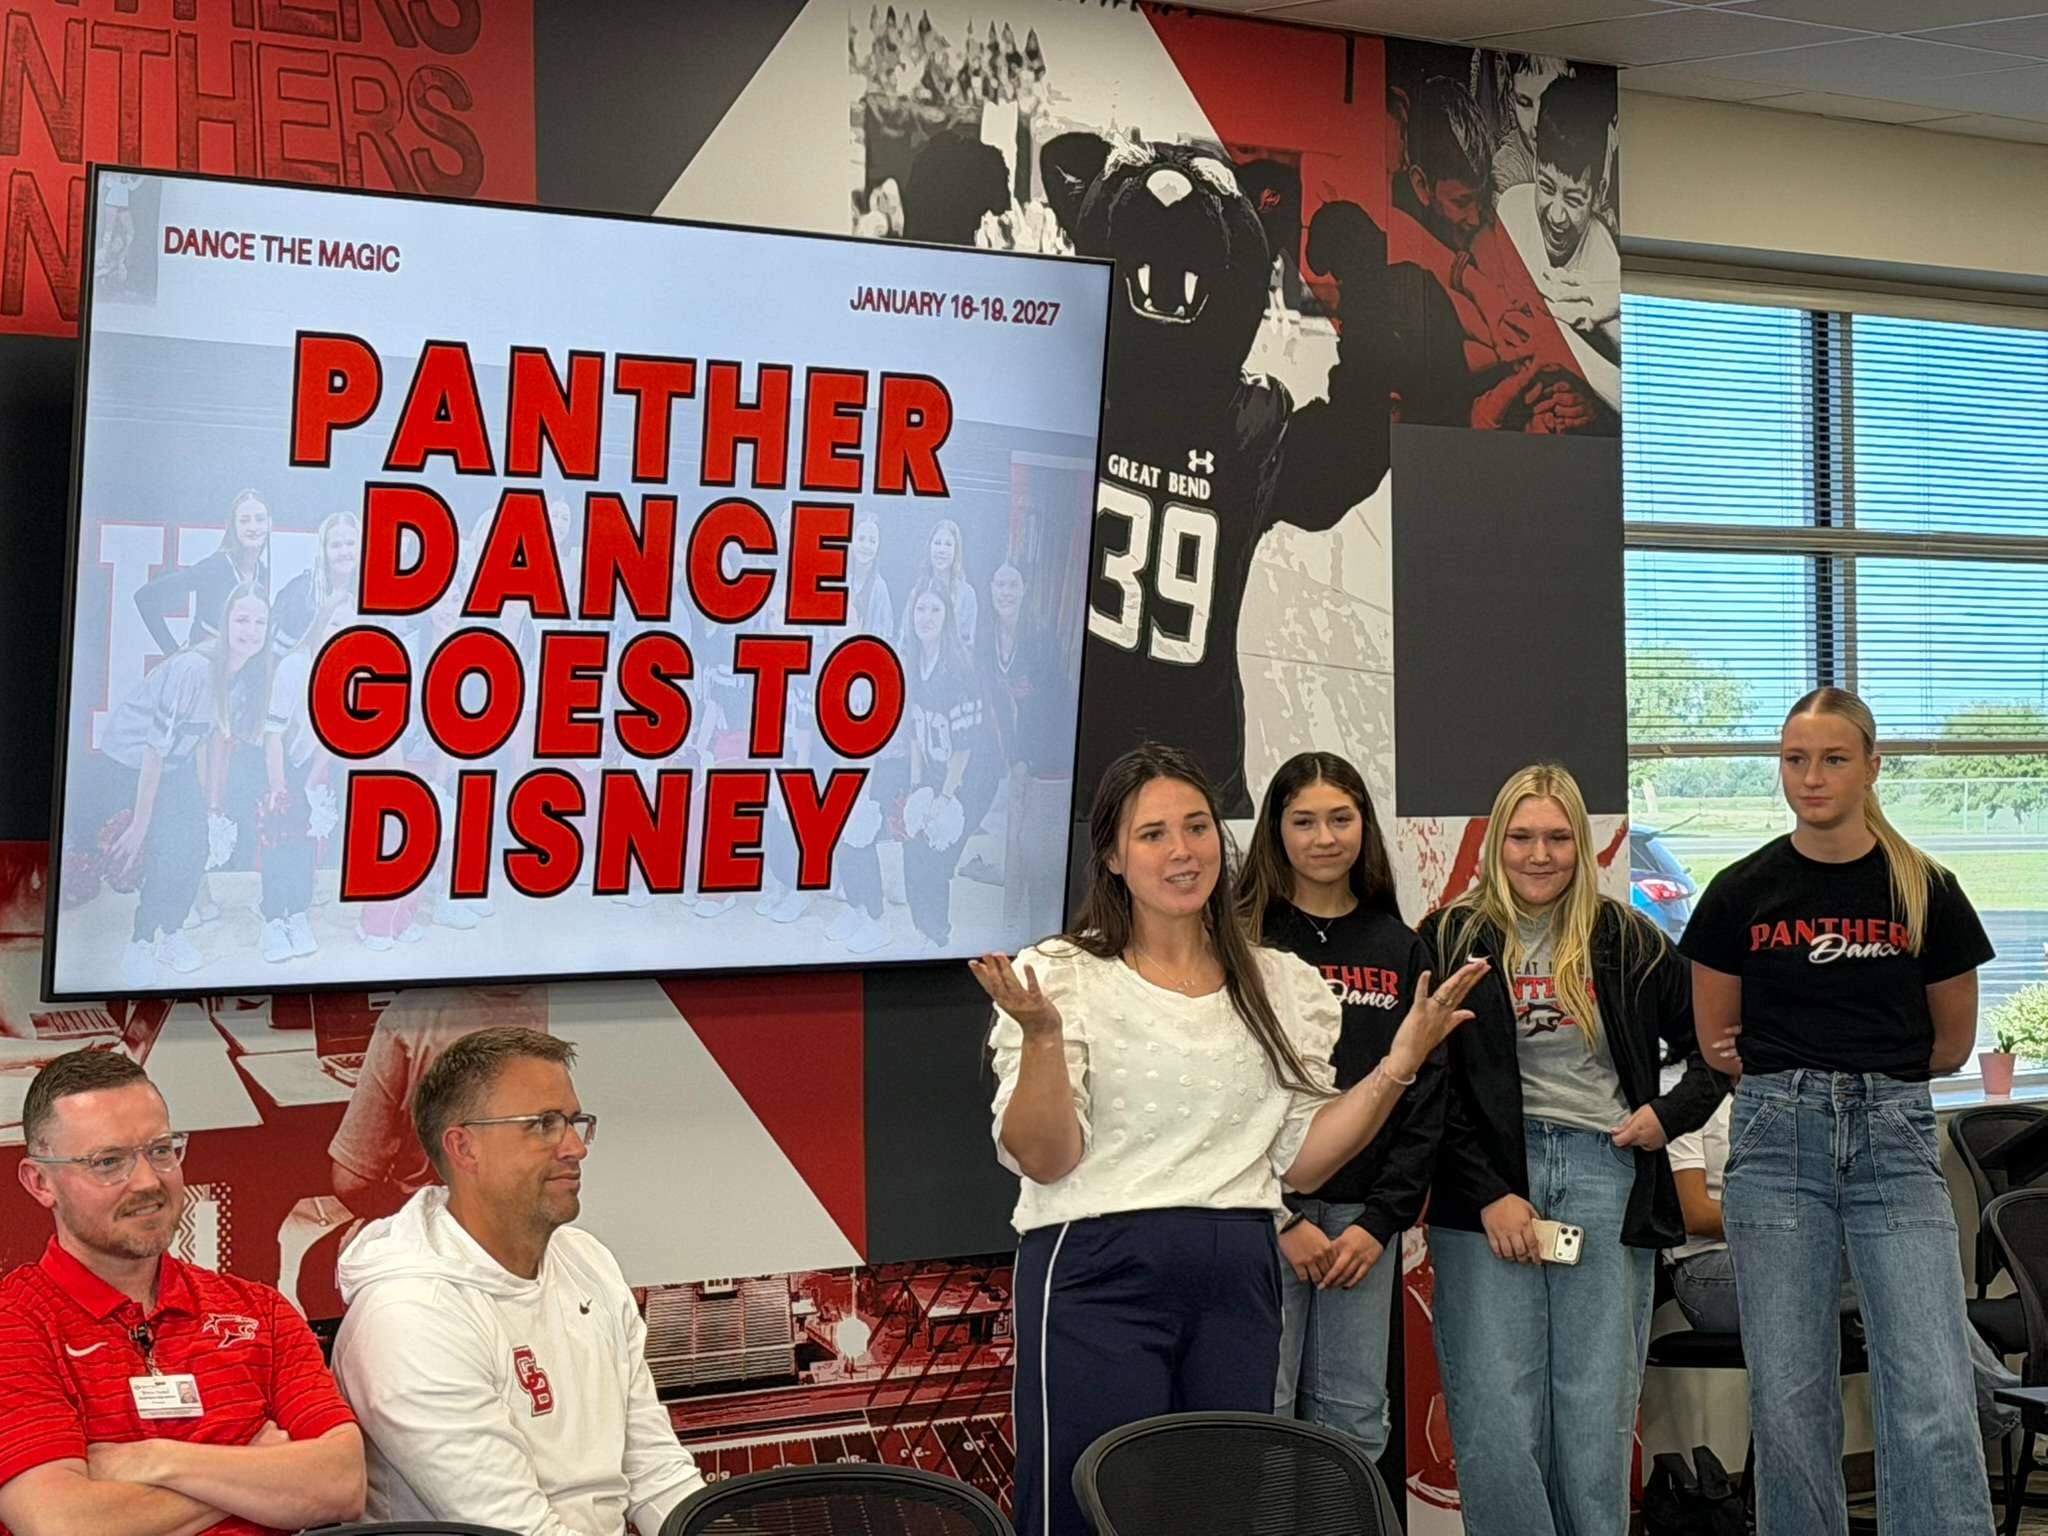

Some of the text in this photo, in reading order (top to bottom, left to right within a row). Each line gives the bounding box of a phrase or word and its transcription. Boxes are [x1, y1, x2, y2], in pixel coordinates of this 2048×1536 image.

[164, 226, 400, 272] DANCE THE MAGIC
[850, 286, 947, 316] JANUARY
[1012, 300, 1060, 326] 2027
[290, 330, 953, 497] PANTHER
[1108, 454, 1210, 500] GREAT BEND
[357, 480, 854, 626] DANCE
[1087, 478, 1219, 666] 39
[308, 625, 694, 760] GOES
[733, 634, 905, 760] TO
[340, 767, 870, 902] DISNEY
[1750, 917, 1909, 951] PANTHER
